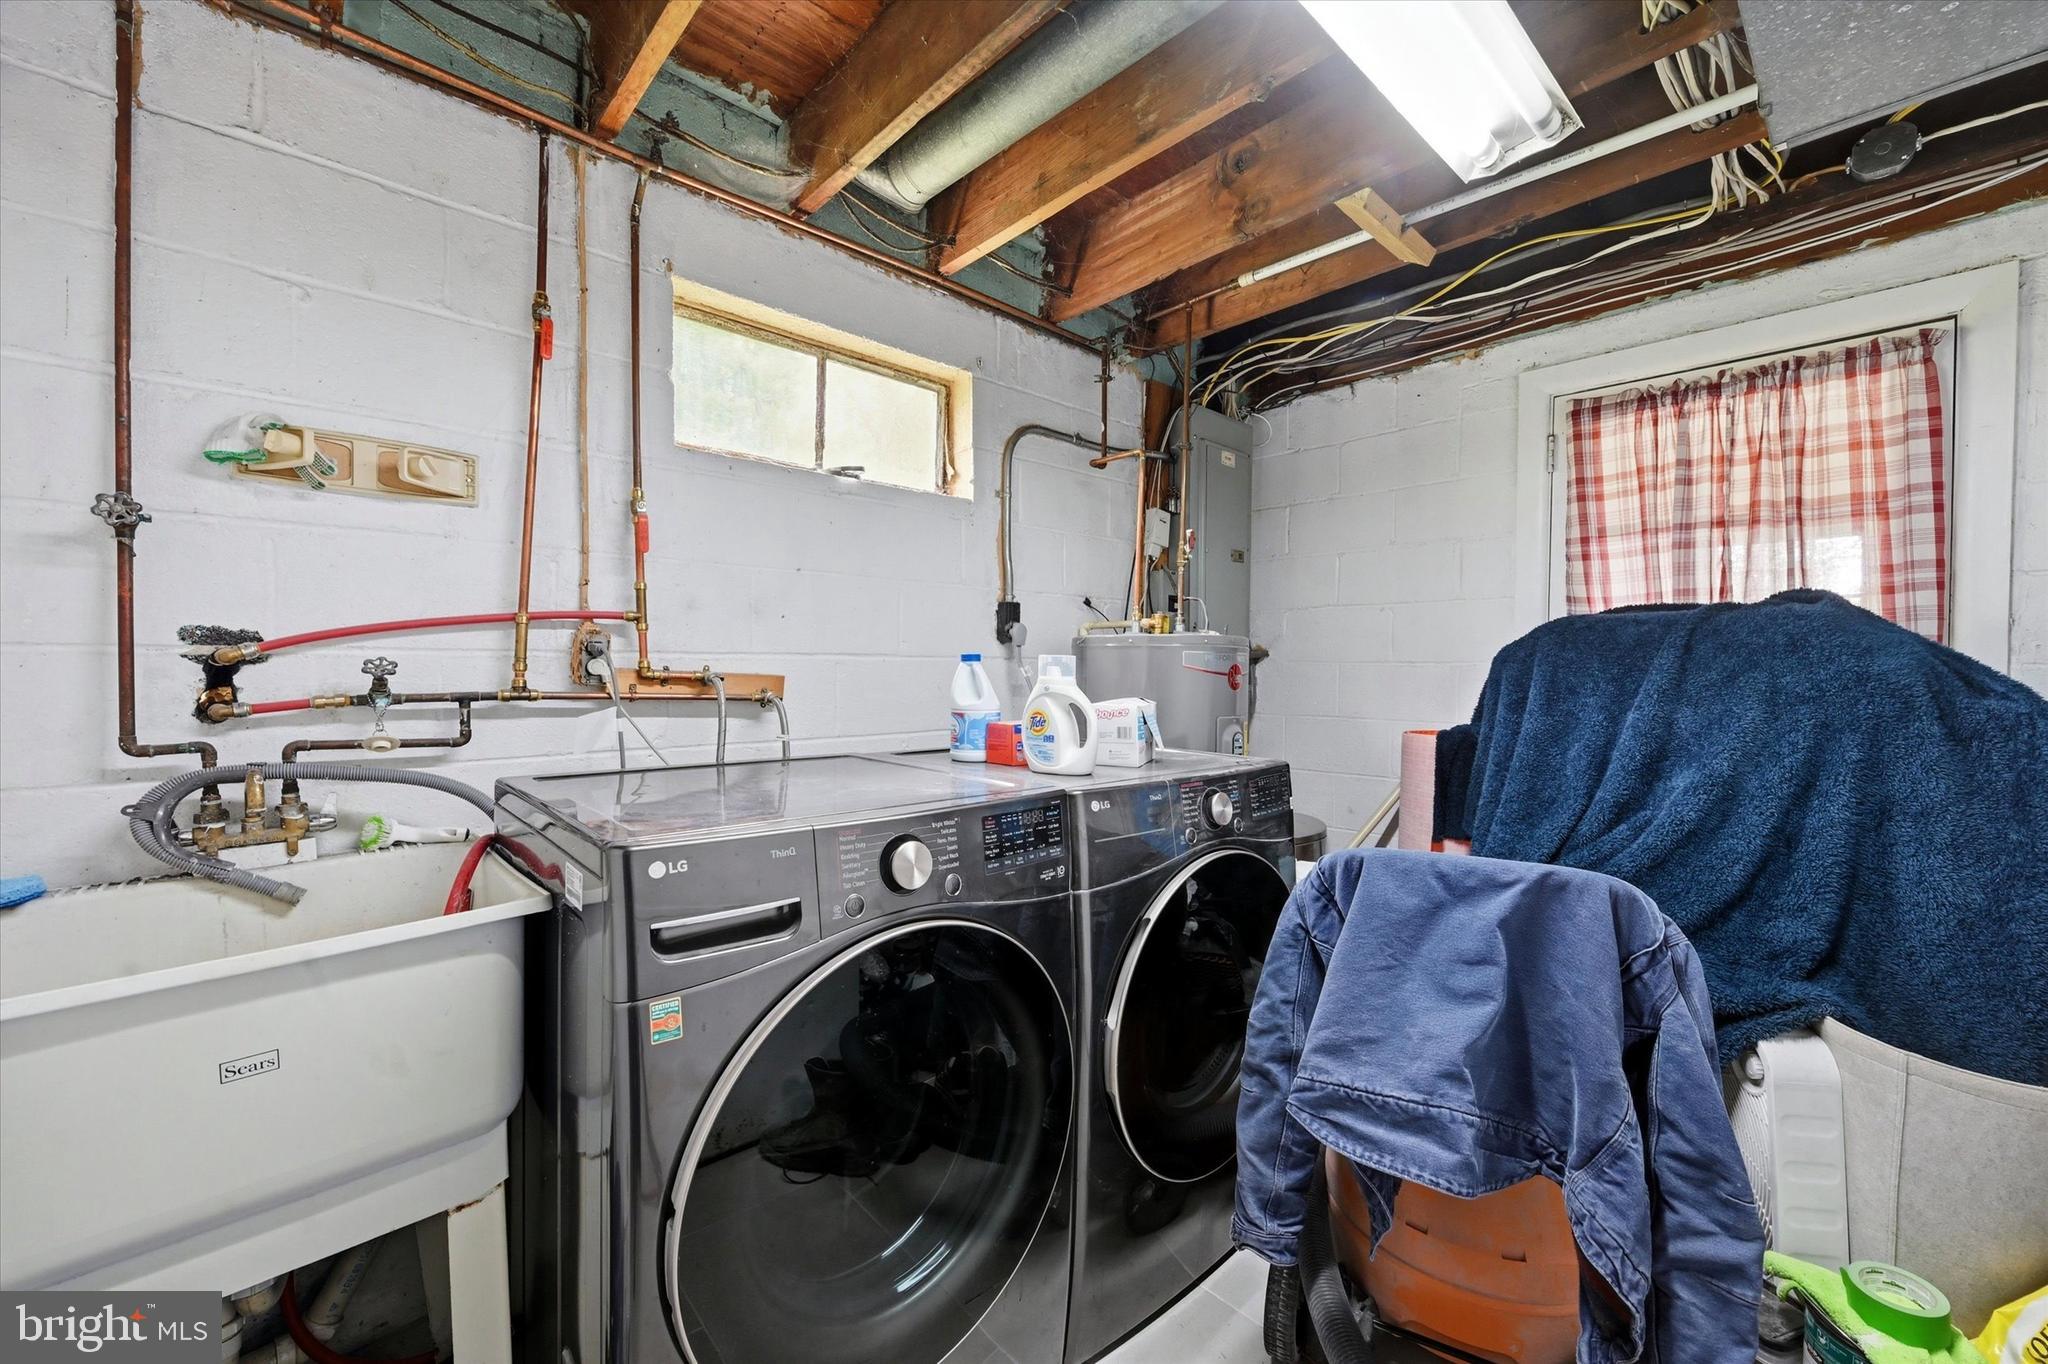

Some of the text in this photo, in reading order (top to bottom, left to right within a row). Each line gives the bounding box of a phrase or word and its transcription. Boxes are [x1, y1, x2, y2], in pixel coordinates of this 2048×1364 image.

[1030, 714, 1047, 731] Tide
[1100, 800, 1111, 809] LG
[770, 846, 797, 859] ThinQ
[668, 860, 689, 874] LG
[224, 1058, 275, 1079] Sears
